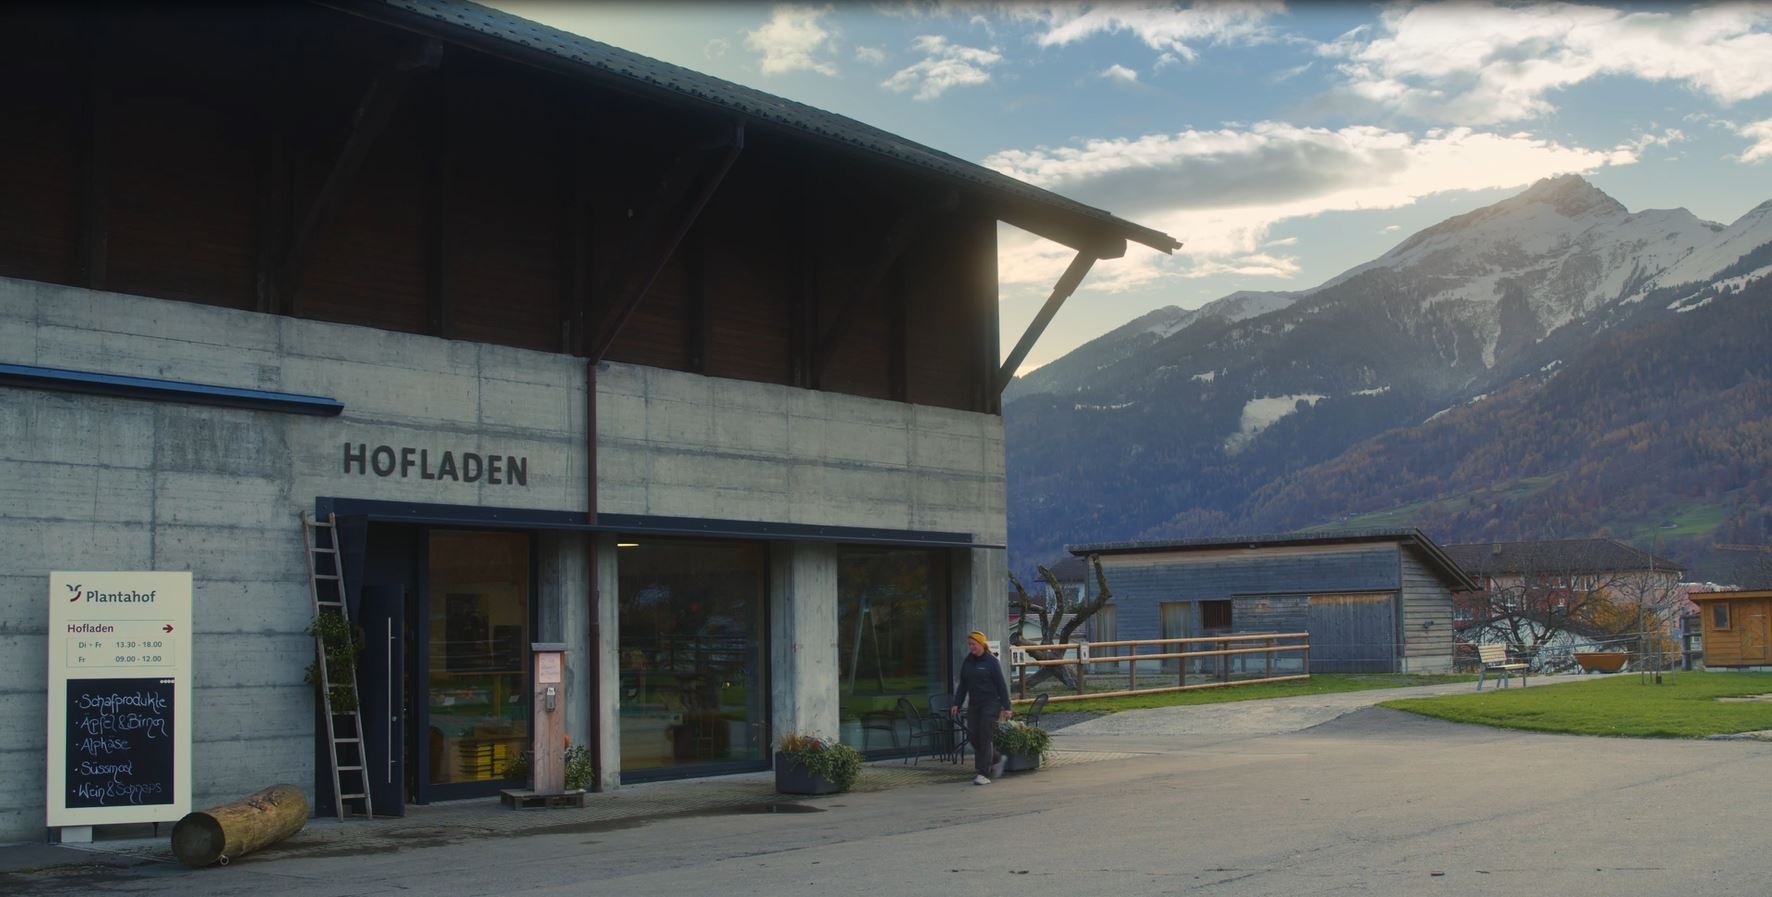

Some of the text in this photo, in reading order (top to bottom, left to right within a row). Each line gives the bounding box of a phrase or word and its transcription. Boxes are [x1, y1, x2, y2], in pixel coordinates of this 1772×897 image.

[343, 442, 528, 486] HOFLADEN
[86, 590, 156, 602] Plantahof
[67, 623, 114, 633] Hofladen
[78, 641, 87, 649] Di
[80, 691, 168, 716] Schafprodukte
[80, 760, 133, 783] Süssmost
[78, 782, 105, 804] Wein
